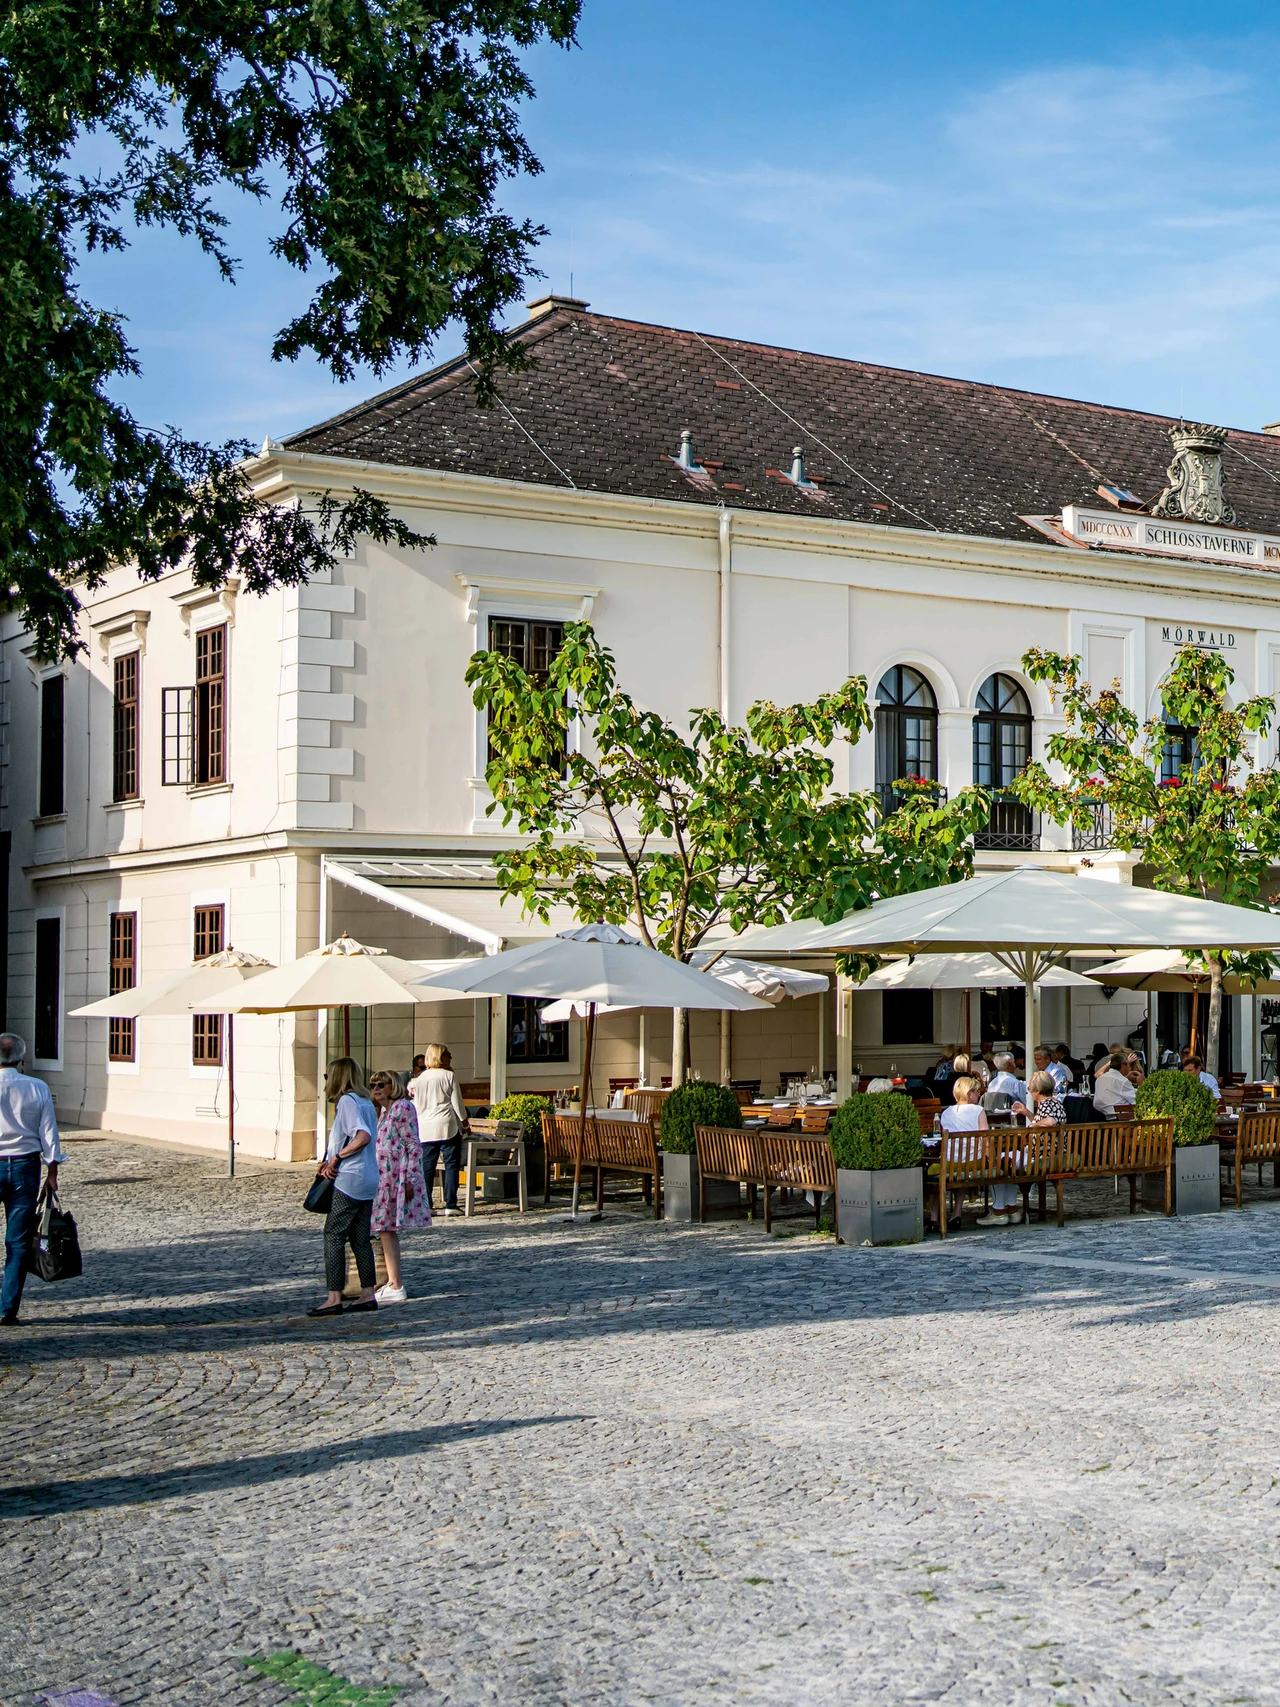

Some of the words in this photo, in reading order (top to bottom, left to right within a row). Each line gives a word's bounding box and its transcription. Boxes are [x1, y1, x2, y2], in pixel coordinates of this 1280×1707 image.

[1081, 521, 1133, 537] MDCCCXXX
[1147, 528, 1254, 555] SCHLOSSTAVERNE
[1162, 625, 1236, 647] MÖRWALD
